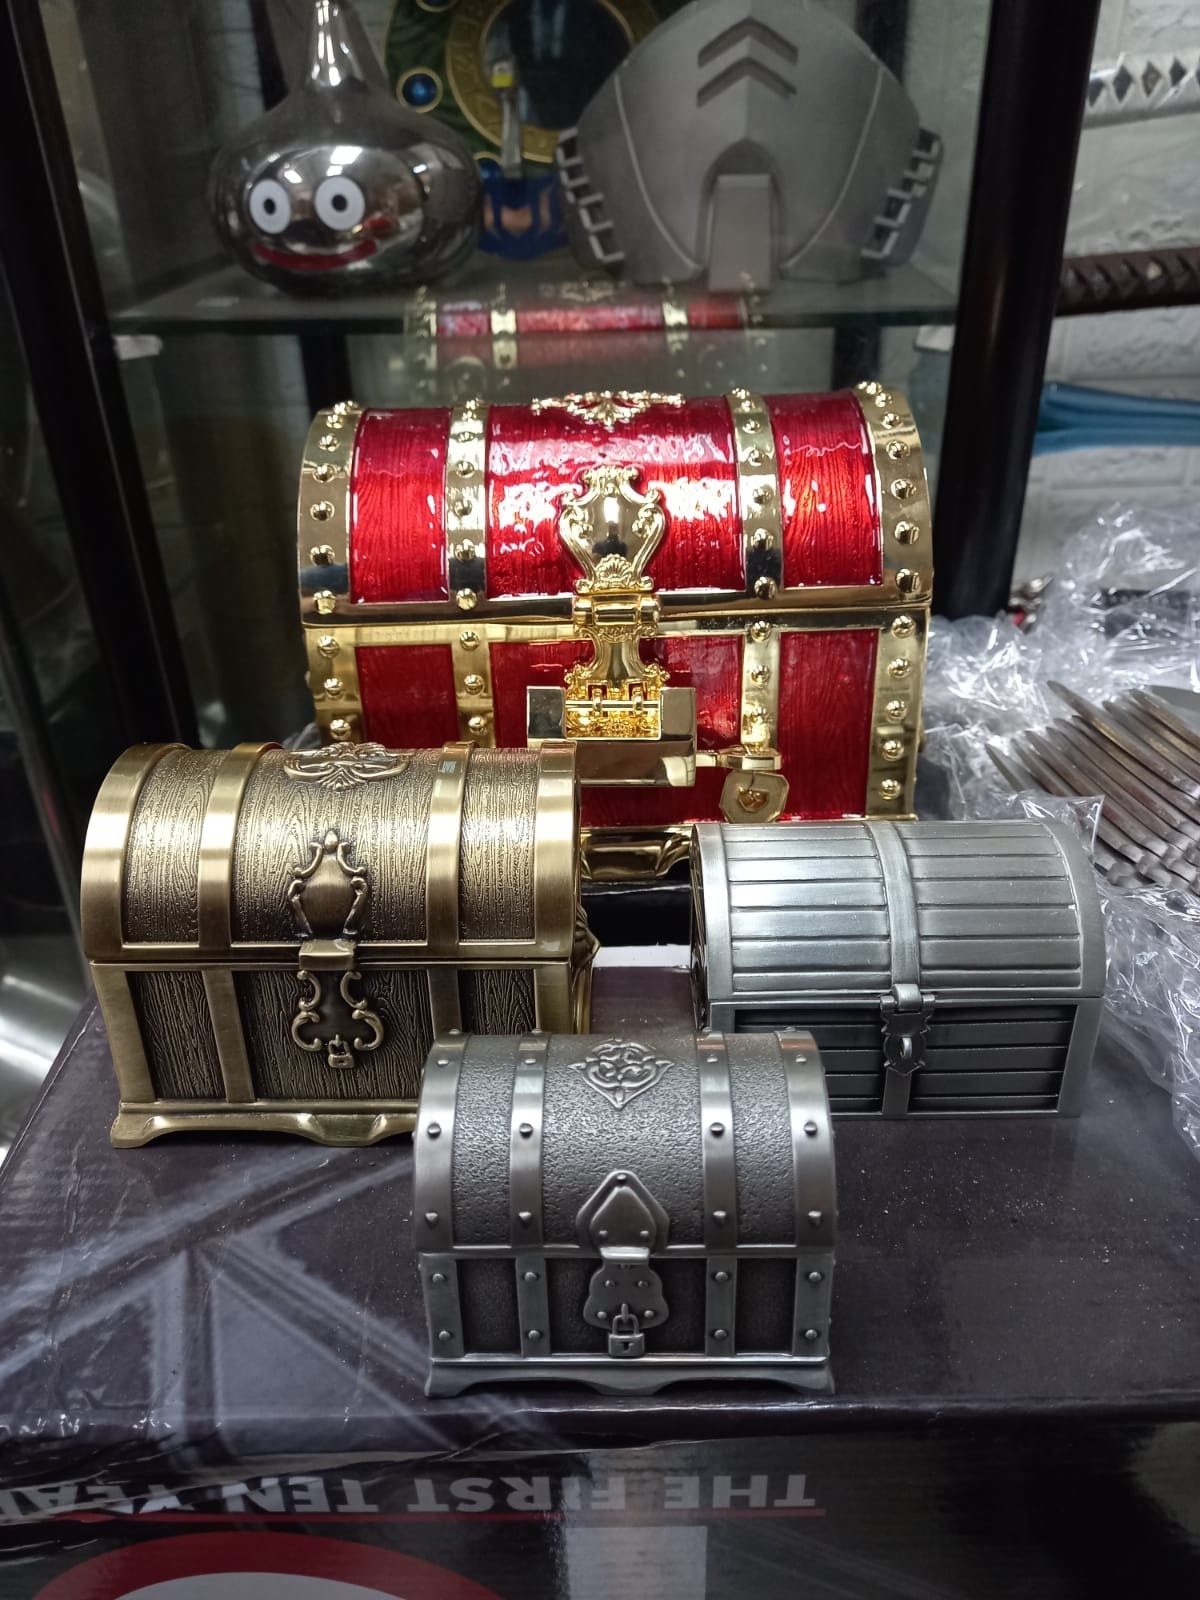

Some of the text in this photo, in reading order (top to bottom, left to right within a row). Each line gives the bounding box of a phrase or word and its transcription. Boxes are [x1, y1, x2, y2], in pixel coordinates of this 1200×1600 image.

[222, 1476, 379, 1513] TEN
[407, 1475, 626, 1512] FIRST
[662, 1474, 816, 1509] THE
